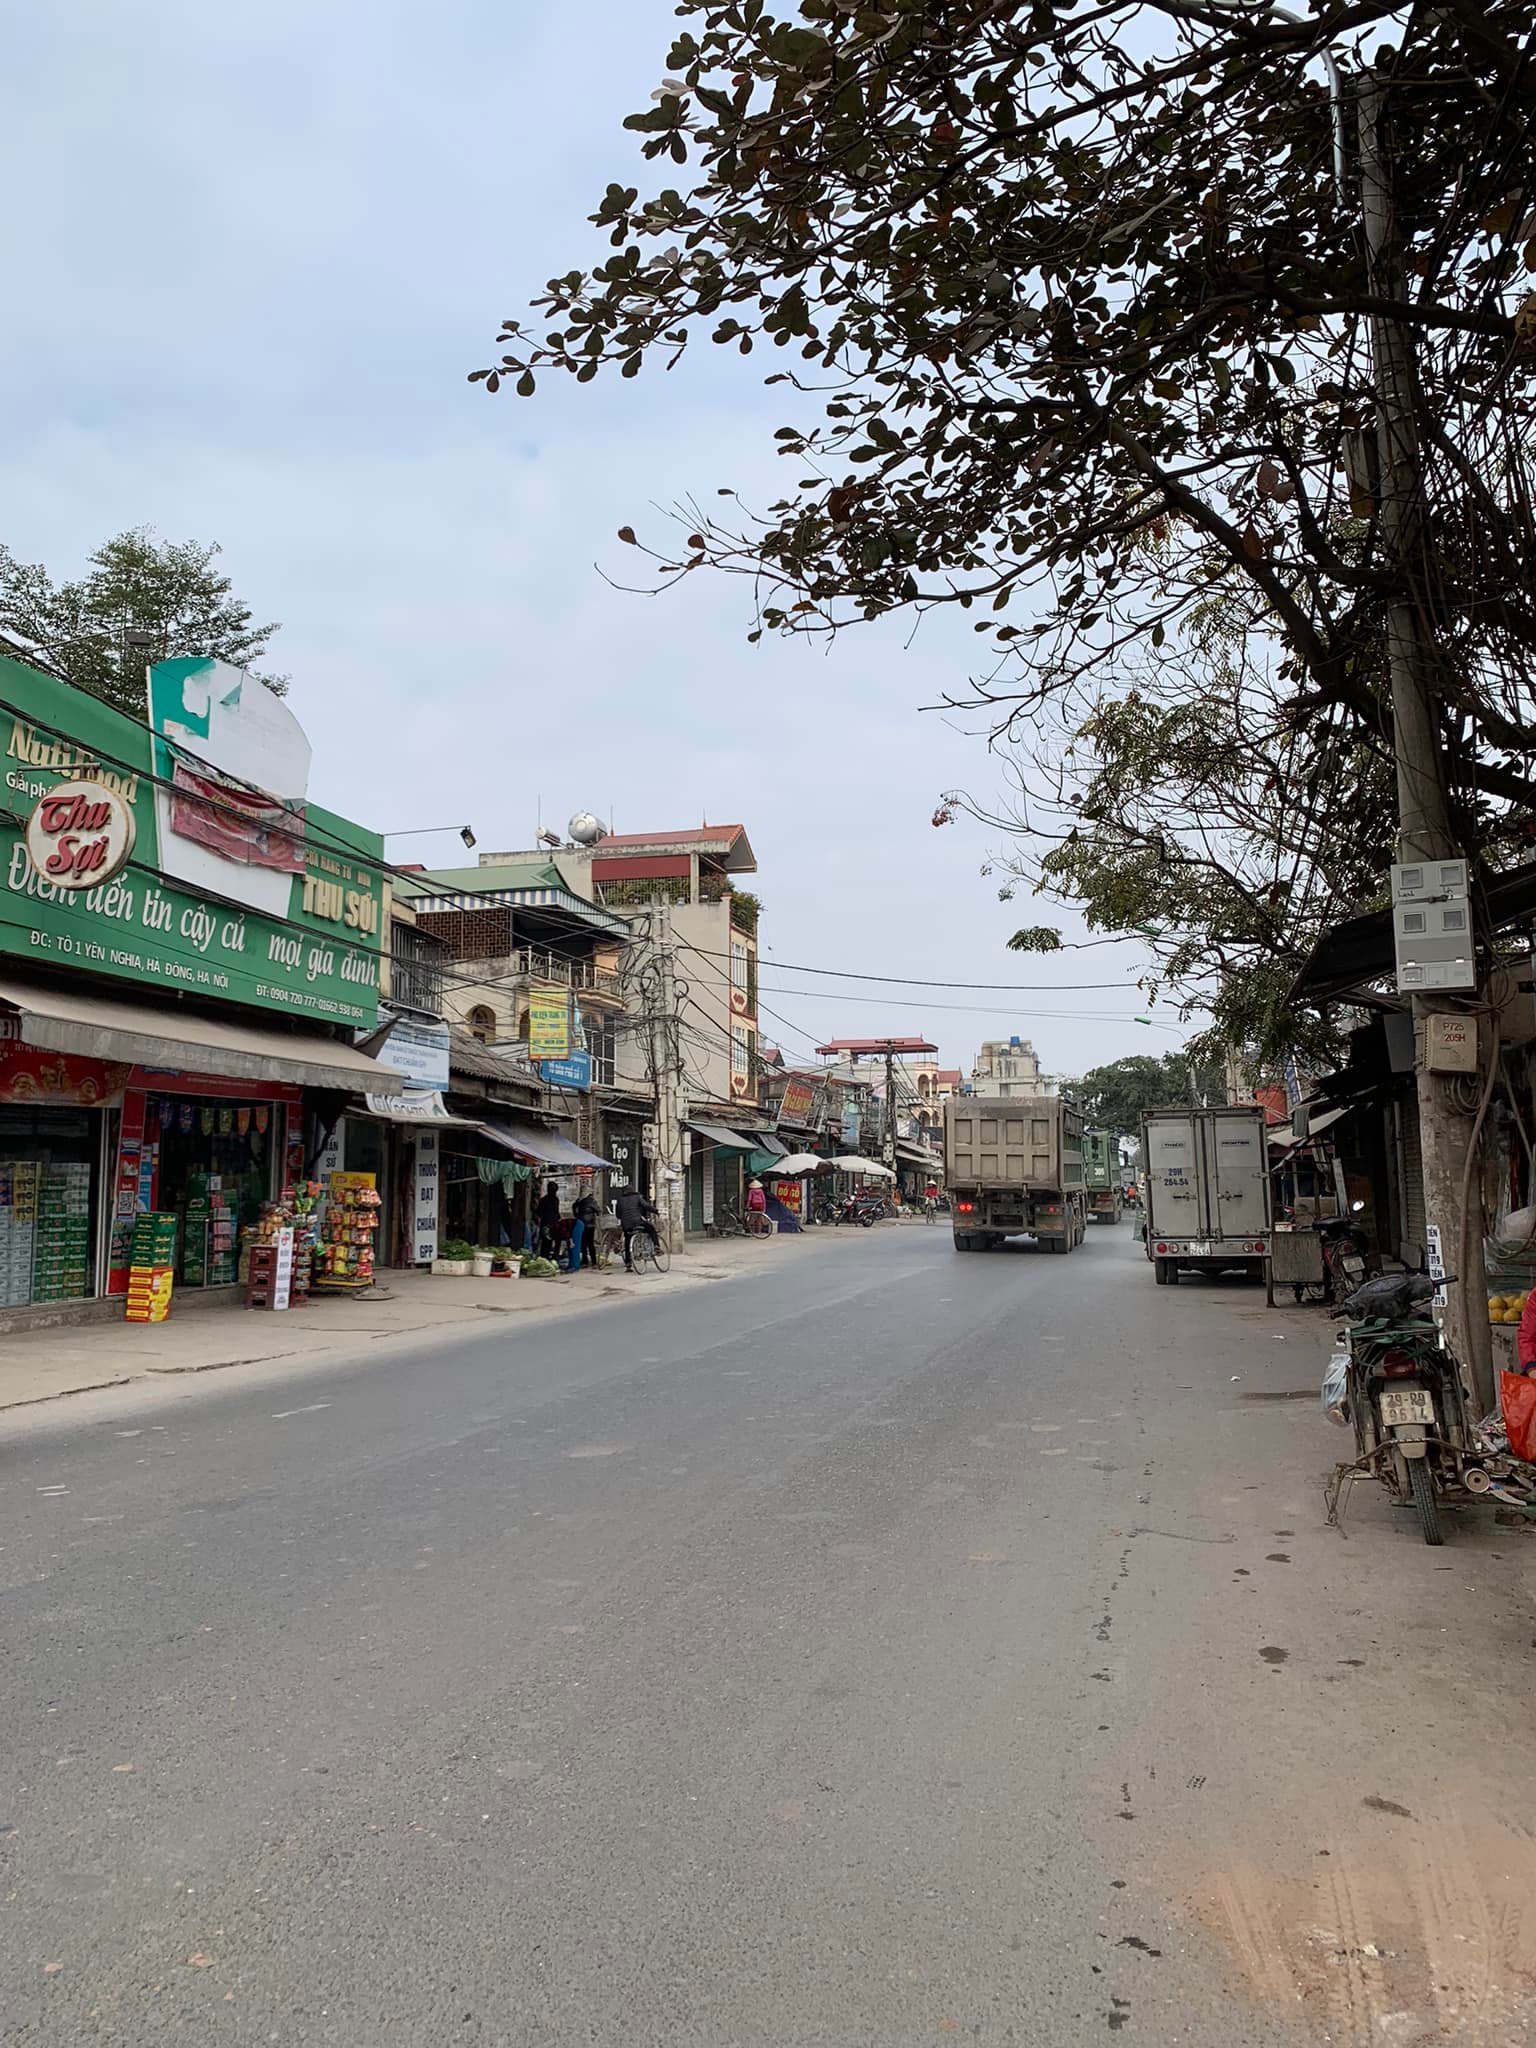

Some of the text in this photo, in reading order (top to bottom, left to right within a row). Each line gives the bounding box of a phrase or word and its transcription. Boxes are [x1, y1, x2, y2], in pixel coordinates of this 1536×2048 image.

[40, 794, 111, 833] Thu
[46, 835, 110, 880] Sợi
[86, 871, 134, 921] đến
[142, 889, 172, 932] tin
[180, 904, 217, 953] cậy
[267, 933, 304, 972] mọi
[307, 941, 334, 981] gia
[303, 873, 378, 939] THU SỢI
[30, 930, 51, 948] ĐC:
[75, 940, 81, 955] 1
[84, 941, 106, 961] YÊN
